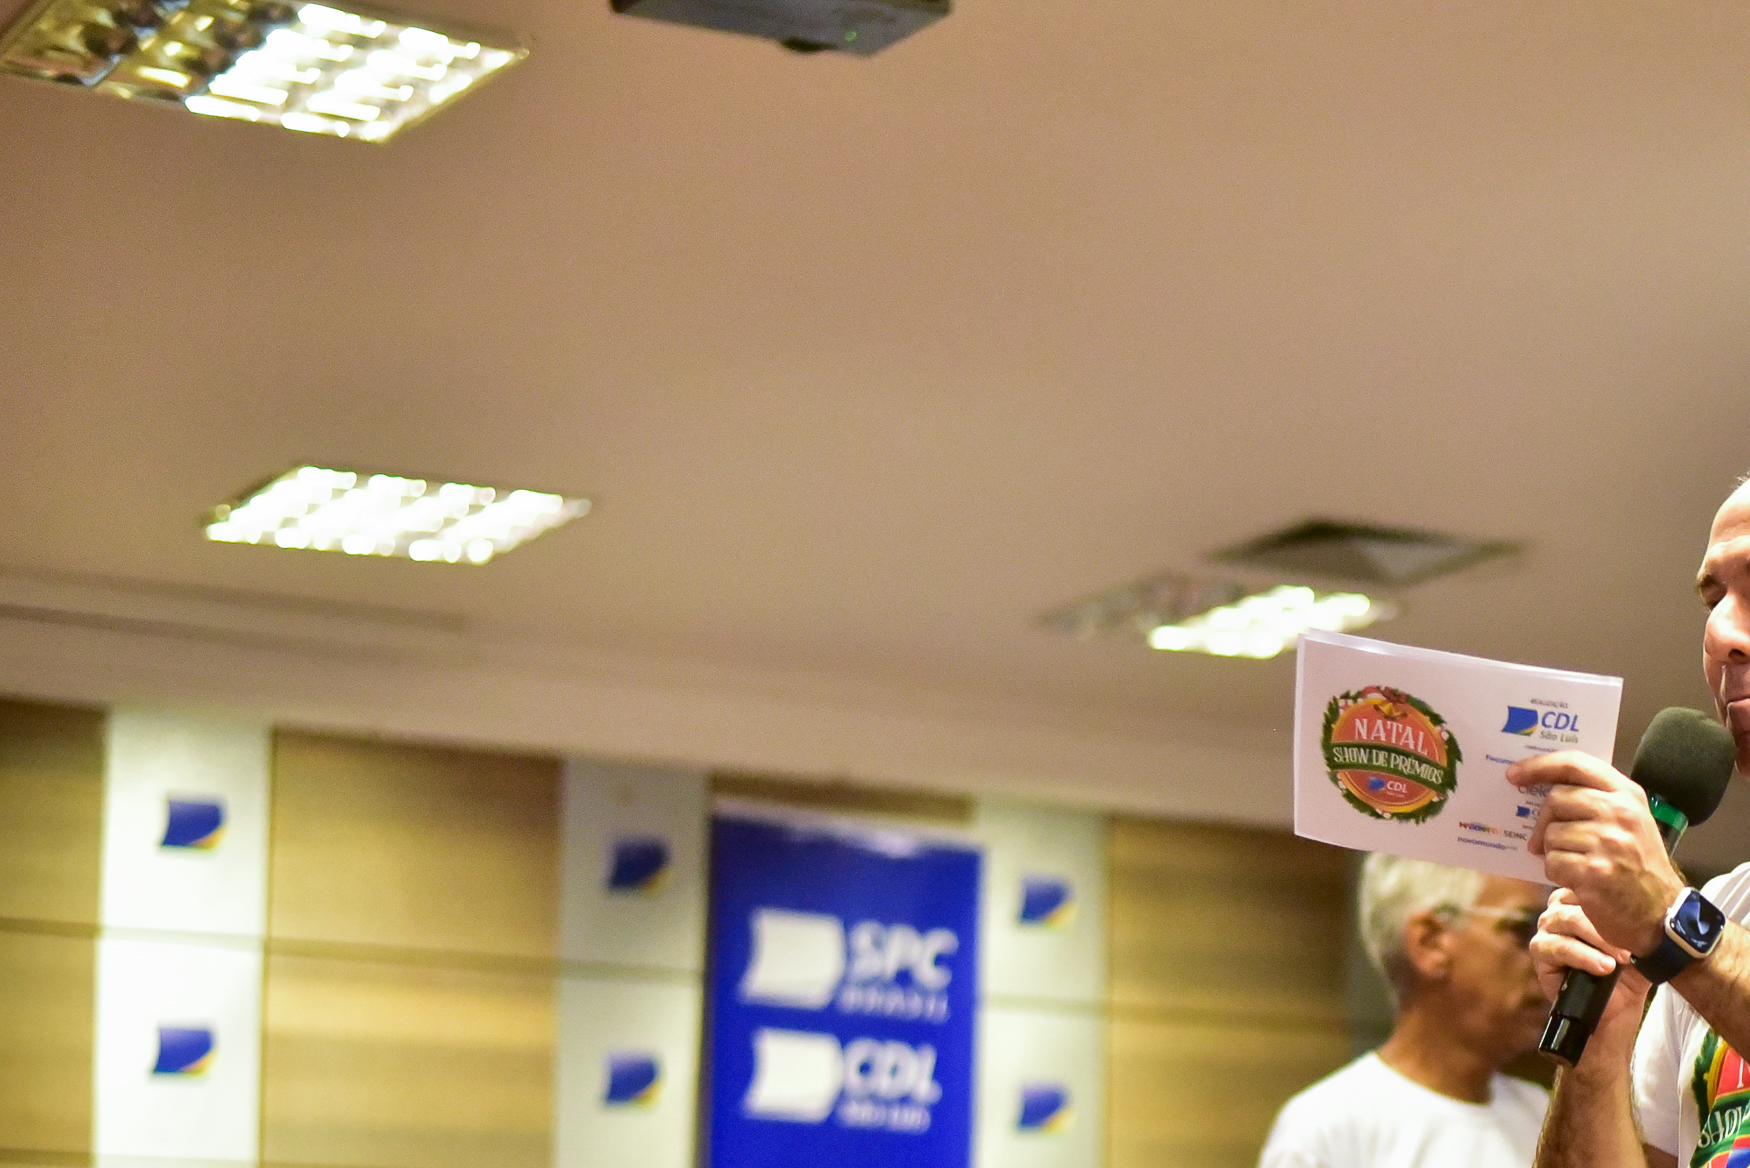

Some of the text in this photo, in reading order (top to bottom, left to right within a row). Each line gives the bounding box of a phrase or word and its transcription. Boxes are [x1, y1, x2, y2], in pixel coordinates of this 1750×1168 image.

[1354, 717, 1428, 756] NATAL
[1541, 711, 1579, 732] CDL
[1332, 746, 1370, 764] SHOW
[1372, 749, 1389, 769] DE
[1387, 780, 1408, 793] CDL
[852, 920, 958, 990] SPC
[845, 1038, 942, 1106] CDL
